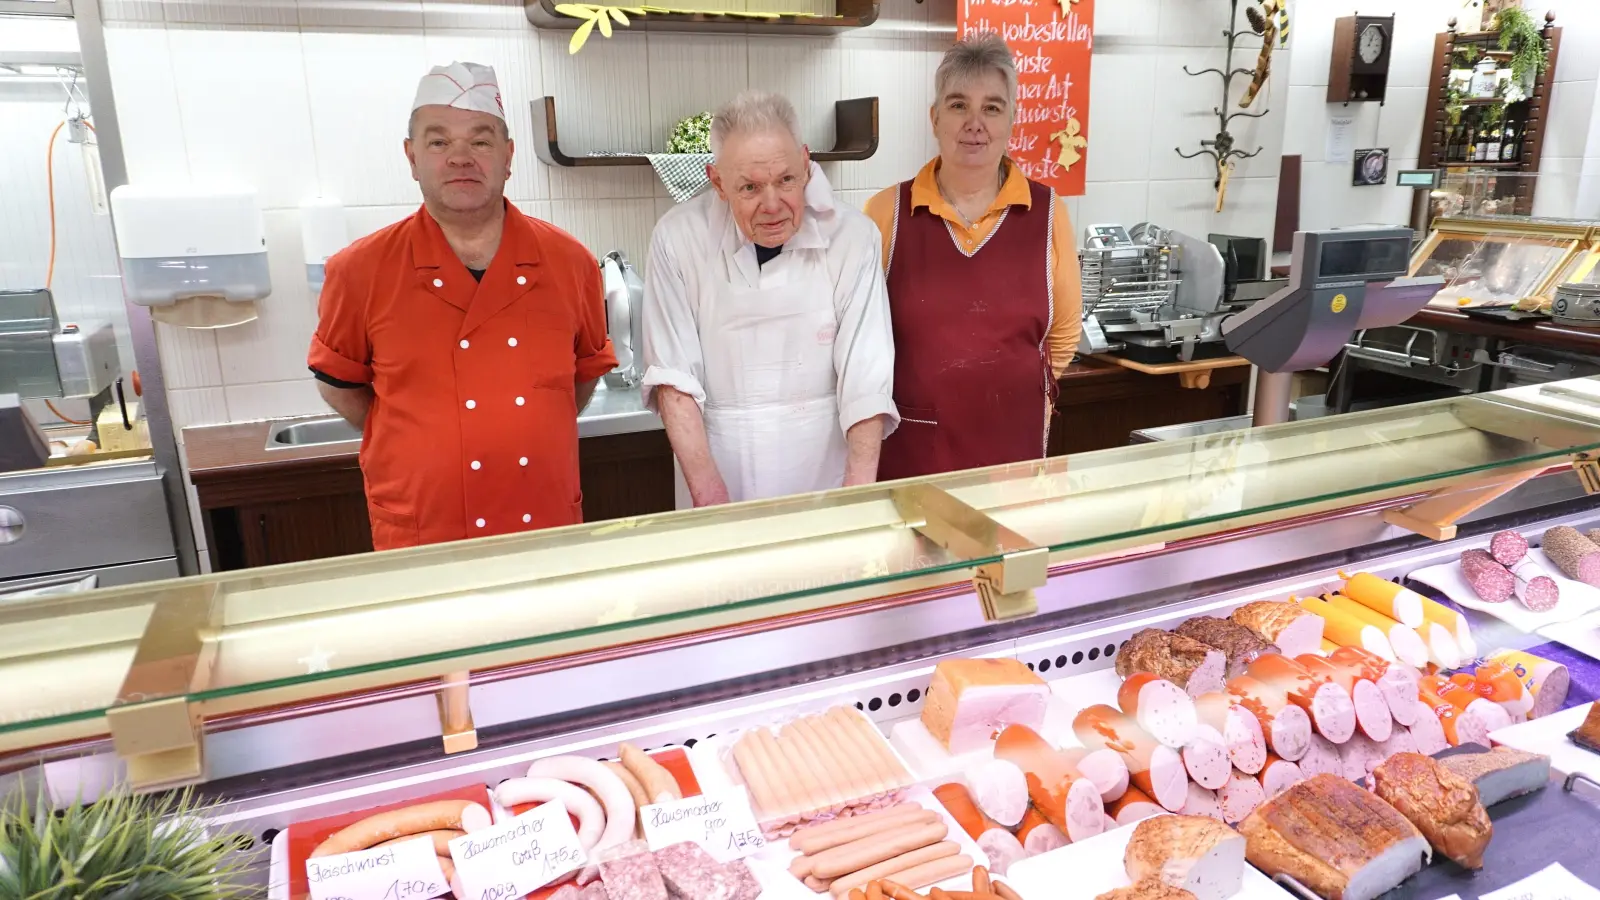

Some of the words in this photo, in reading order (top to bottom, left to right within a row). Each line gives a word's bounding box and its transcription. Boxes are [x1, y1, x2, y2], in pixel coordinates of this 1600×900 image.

[1012, 46, 1053, 73] ürste
[1016, 82, 1047, 100] ner
[1017, 147, 1060, 179] ürste
